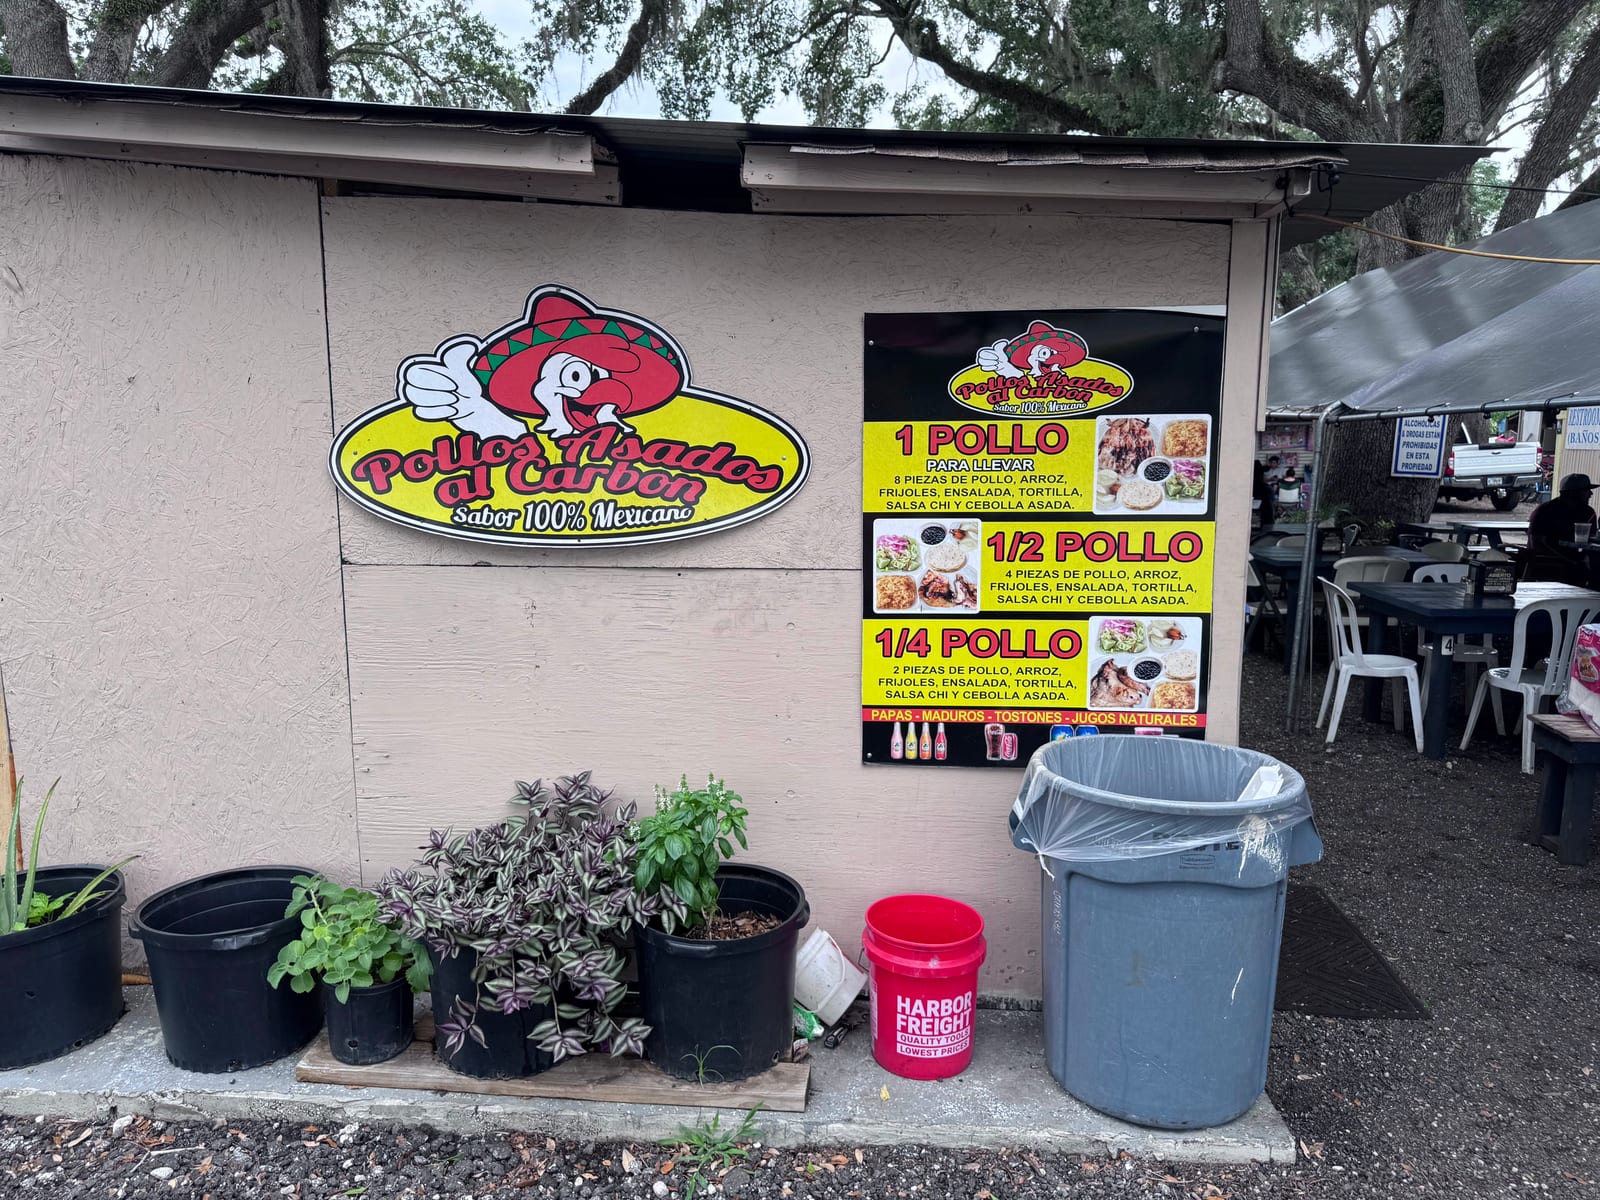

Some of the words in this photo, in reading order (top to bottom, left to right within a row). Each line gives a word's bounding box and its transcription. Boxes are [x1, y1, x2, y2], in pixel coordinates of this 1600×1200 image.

[956, 376, 1028, 399] Pollos
[1036, 372, 1124, 397] Asados
[988, 390, 1008, 404] al
[1016, 384, 1092, 402] Carbon
[994, 403, 1018, 412] Sabor
[1022, 402, 1044, 413] 100%
[1048, 402, 1087, 412] Mexicano
[896, 424, 913, 456] 1
[928, 423, 1069, 456] POLLO
[1402, 441, 1438, 449] PROHIBIDAS
[353, 434, 542, 492] Pollos
[558, 425, 780, 490] Asados
[1416, 452, 1430, 460] ESTA
[926, 459, 970, 472] PARA
[972, 459, 1034, 472] LLEVAR
[437, 466, 491, 505] al
[508, 457, 704, 502] Carbon
[894, 475, 901, 484] 8
[904, 475, 947, 485] PIEZAS
[952, 475, 969, 484] DE
[972, 475, 1016, 486] POLLO,
[1020, 475, 1067, 486] ARROZ,
[879, 488, 940, 498] FRIJOLES,
[944, 488, 1014, 498] ENSALADA,
[1018, 488, 1083, 498] TORTILLA,
[886, 501, 926, 510] SALSA
[930, 501, 950, 510] CHI
[954, 501, 962, 510] Y
[965, 501, 1023, 510] CEBOLLA
[1027, 501, 1075, 510] ASADA.
[453, 506, 519, 528] Sabor
[524, 502, 585, 530] 100%
[592, 501, 692, 529] Mexicano
[987, 531, 1044, 563] 1/2
[1056, 531, 1203, 563] POLLO
[1005, 570, 1012, 579] 4
[1016, 570, 1060, 579] PIEZAS
[1064, 570, 1080, 579] DE
[1084, 570, 1130, 580] POLLO,
[1134, 570, 1181, 580] ARROZ,
[990, 583, 1052, 593] FRIJOLES,
[1056, 583, 1128, 593] ENSALADA,
[1132, 583, 1197, 593] TORTILLA,
[997, 595, 1038, 604] SALSA
[1042, 595, 1062, 604] CHI
[1066, 595, 1074, 604] Y
[1078, 595, 1136, 604] CEBOLLA
[1141, 596, 1189, 605] ASADA.
[876, 628, 931, 658] 1/4
[942, 628, 1082, 659] POLLO
[1445, 639, 1452, 652] 4
[893, 666, 899, 675] 2
[903, 666, 945, 675] PIEZAS
[949, 666, 965, 675] DE
[968, 666, 1012, 676] POLLO,
[1016, 667, 1062, 677] ARROZ,
[878, 678, 938, 688] FRIJOLES,
[942, 679, 1010, 688] ENSALADA,
[1014, 679, 1077, 689] TORTILLA,
[886, 691, 924, 699] SALSA
[928, 691, 948, 699] CHI
[952, 691, 959, 699] Y
[963, 691, 1019, 700] CEBOLLA
[1023, 692, 1069, 700] ASADA.
[871, 711, 912, 721] PAPAS
[922, 711, 985, 721] MADUROS
[996, 711, 1062, 722] TOSTONES
[1072, 713, 1116, 723] JUGOS
[1119, 713, 1197, 726] NATURALES
[897, 991, 972, 1018] HARBOR
[897, 1008, 972, 1035] FREIGHT
[900, 1034, 944, 1045] QUALITY
[945, 1028, 968, 1043] TOOLS
[900, 1046, 939, 1056] LOWEST
[941, 1040, 968, 1055] PRICES
